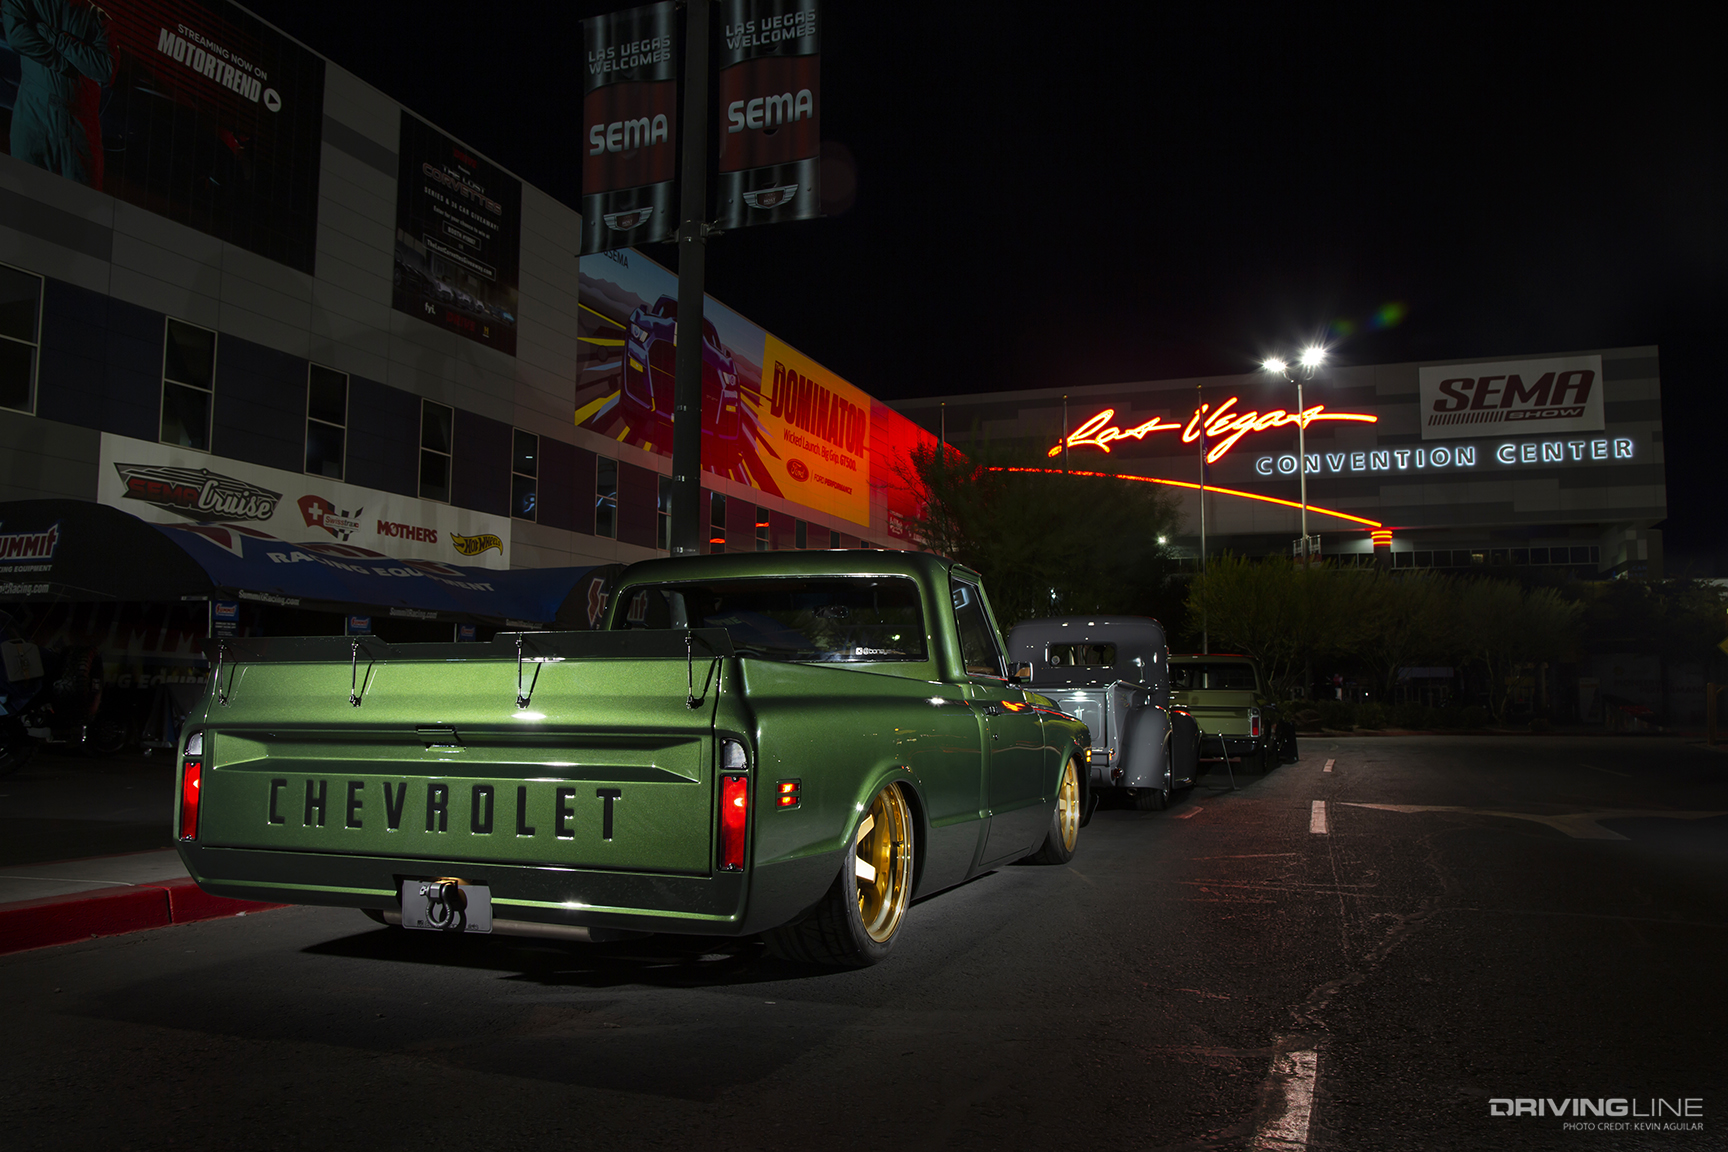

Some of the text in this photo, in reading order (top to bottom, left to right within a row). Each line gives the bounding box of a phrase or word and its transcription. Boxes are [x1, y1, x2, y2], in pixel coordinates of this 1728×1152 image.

[726, 9, 816, 37] LAS VEGAS
[726, 22, 816, 50] WELCOMES
[178, 23, 268, 81] STREAMING NOW ON
[588, 35, 671, 62] LAS VEGAS
[588, 51, 671, 75] WELCOMES
[157, 27, 263, 103] MOTORTREND
[727, 88, 813, 134] SEMA
[589, 113, 668, 156] SEMA
[422, 162, 502, 216] CORVETTES
[442, 164, 460, 181] THE
[462, 175, 485, 194] LOST
[424, 186, 444, 203] SERIES
[459, 204, 470, 216] CAR
[1432, 369, 1596, 412] SEMA
[770, 360, 867, 459] DOMINATOR
[1507, 406, 1583, 420] SHOW
[783, 427, 803, 448] Wicked
[803, 437, 821, 456] Launch.
[1048, 396, 1379, 464] Las Vegas
[1256, 438, 1633, 475] CONVENTION CENTER
[126, 477, 273, 520] SEMA Cruise
[377, 519, 438, 544] MOTHERS
[463, 536, 501, 553] HOT WHEELS
[13, 565, 53, 573] EQUIPMENT
[1639, 686, 1707, 694] PERFORMANC
[267, 777, 622, 842] CHEVROLET
